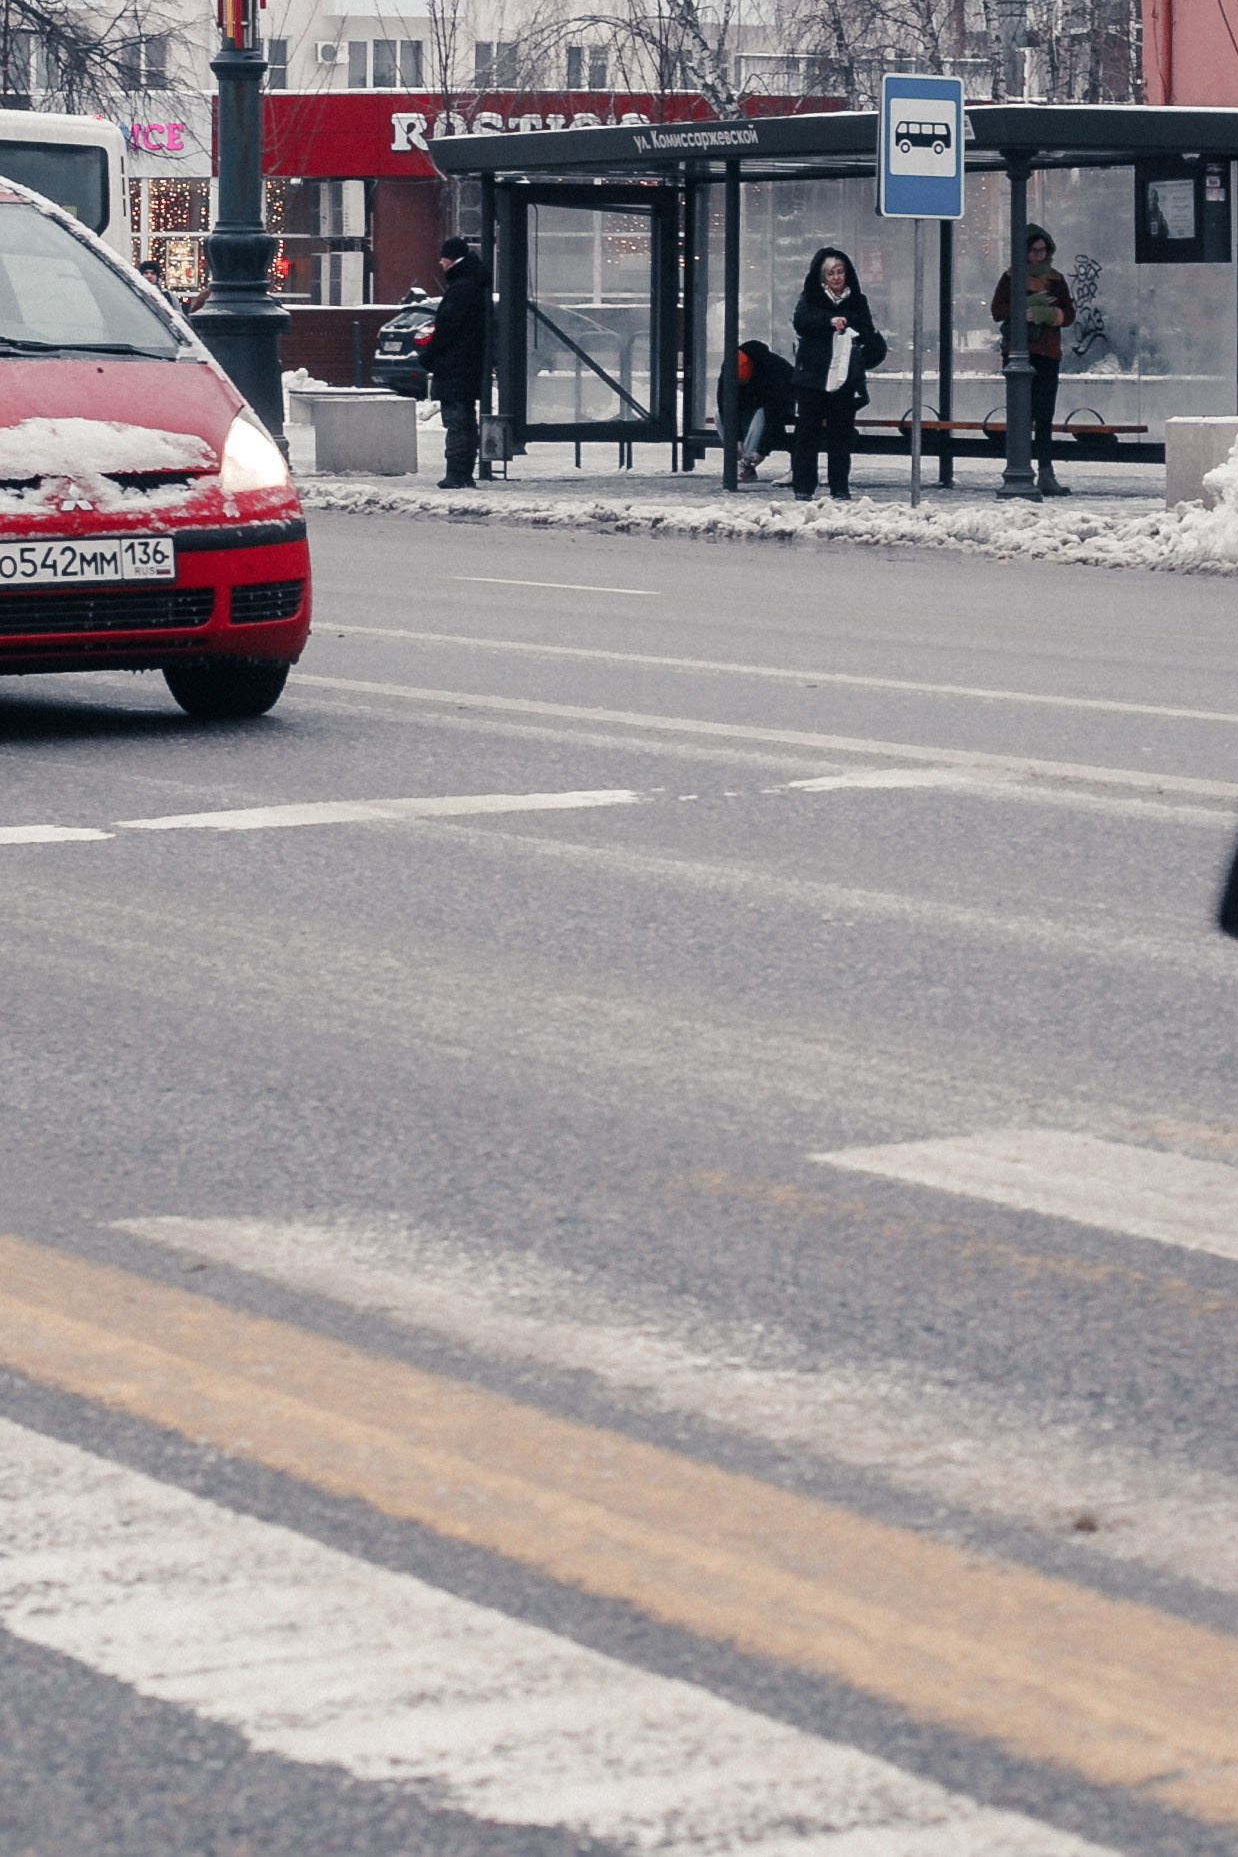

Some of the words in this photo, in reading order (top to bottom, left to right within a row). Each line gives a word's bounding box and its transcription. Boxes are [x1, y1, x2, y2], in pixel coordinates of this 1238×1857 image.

[633, 135, 651, 154] ул.
[650, 124, 759, 151] Комиссаржевской
[124, 541, 165, 566] 136
[134, 566, 157, 575] RUS
